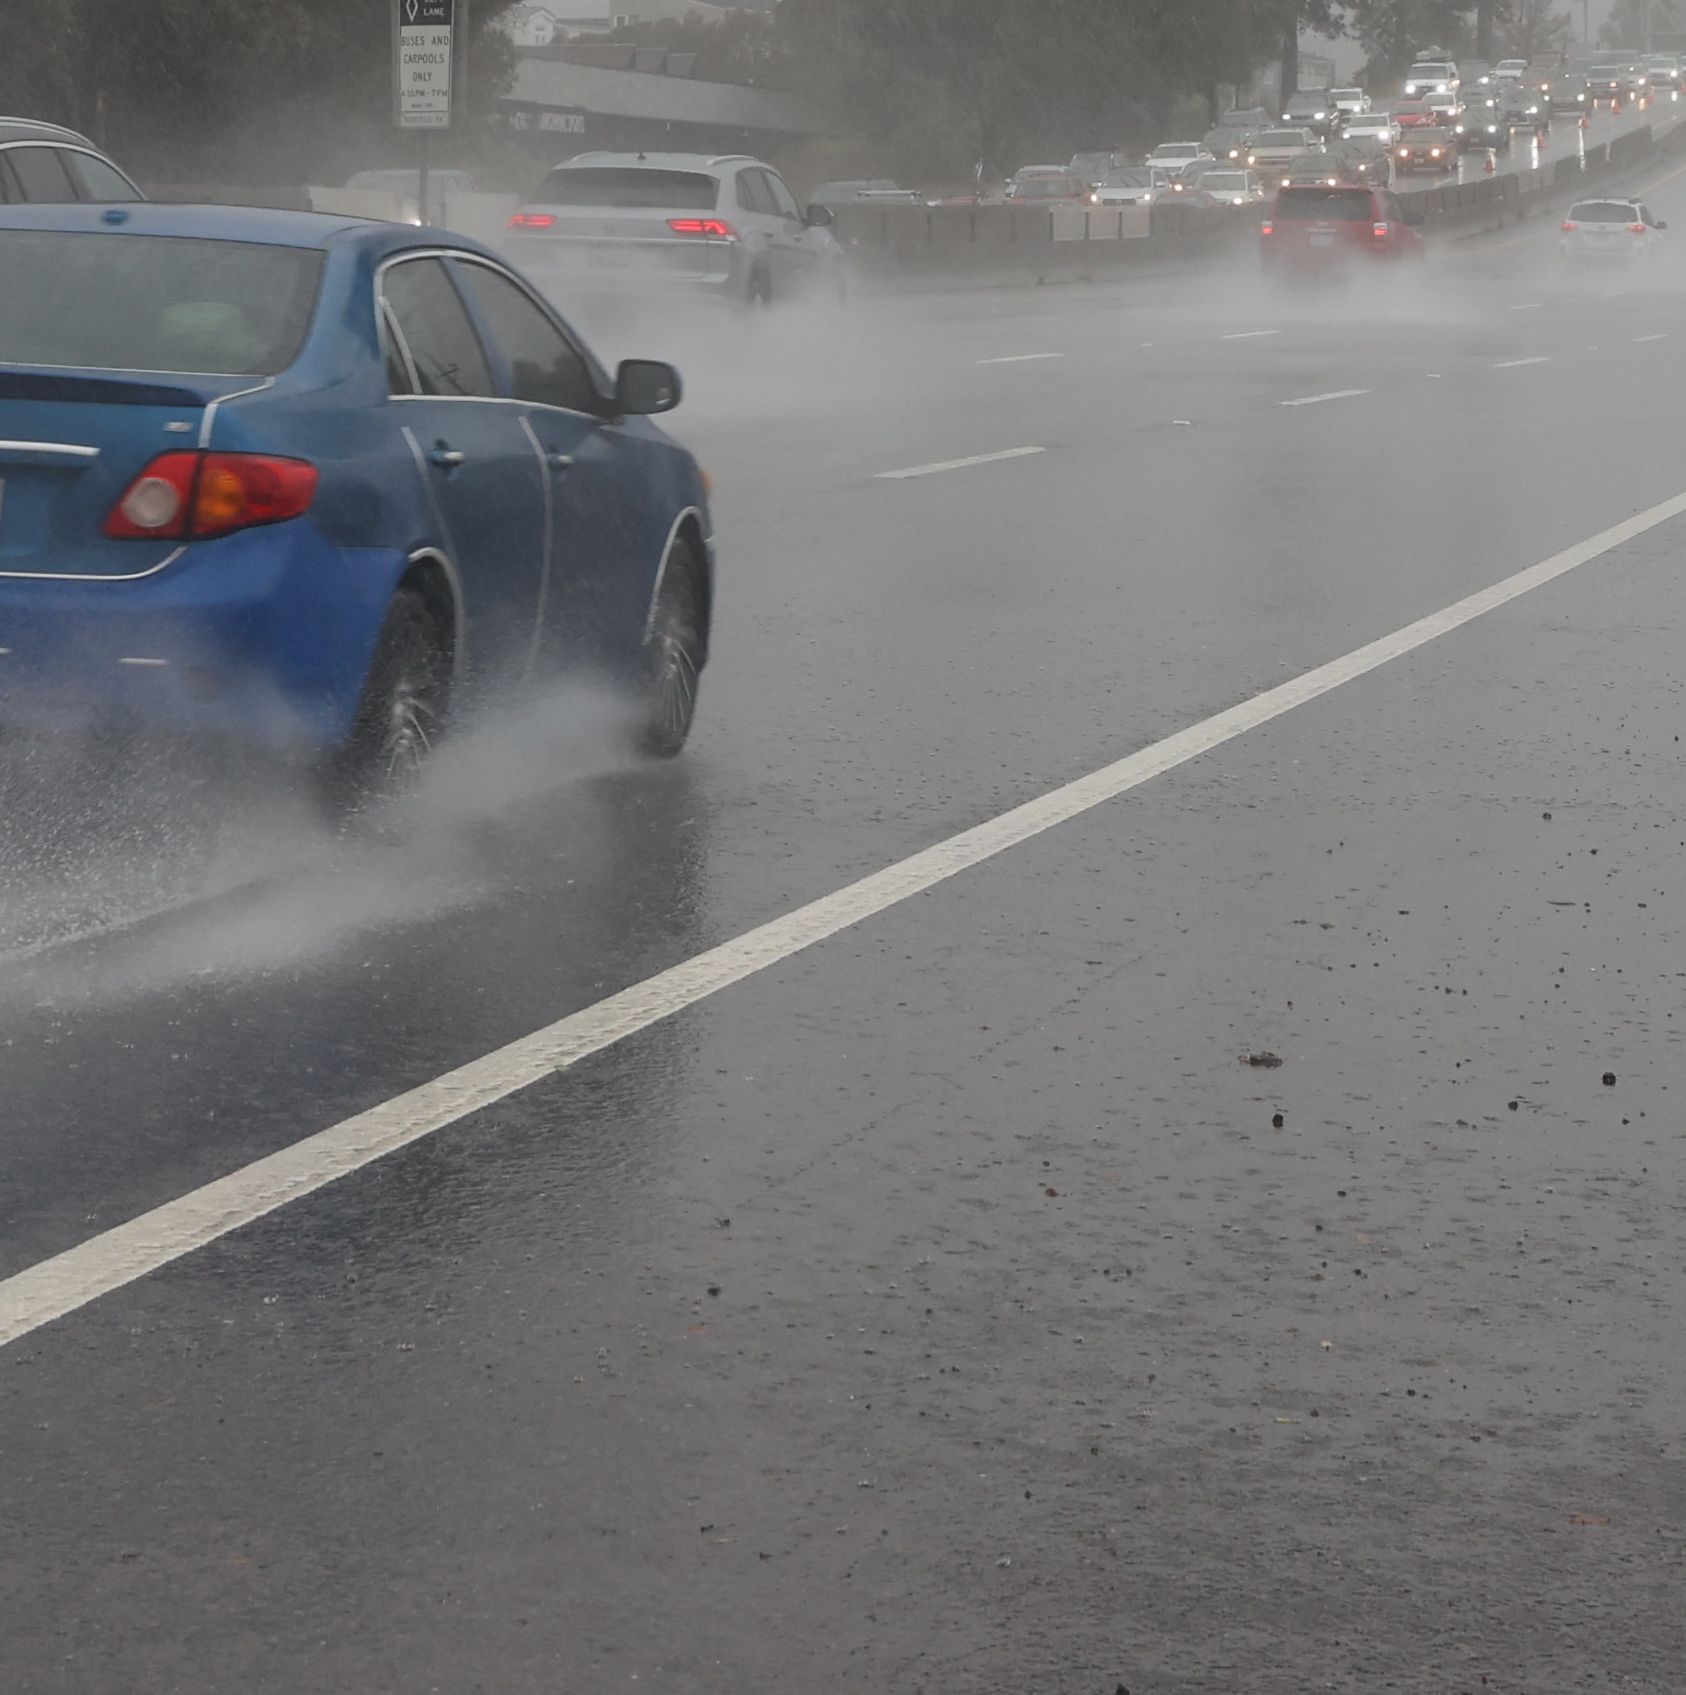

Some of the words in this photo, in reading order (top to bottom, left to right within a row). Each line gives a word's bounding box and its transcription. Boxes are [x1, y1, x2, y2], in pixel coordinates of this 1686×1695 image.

[423, 7, 445, 16] LANE
[401, 36, 425, 47] BUSES
[431, 36, 449, 46] AND
[403, 53, 445, 65] CARPOOLS
[412, 71, 433, 83] ONLY
